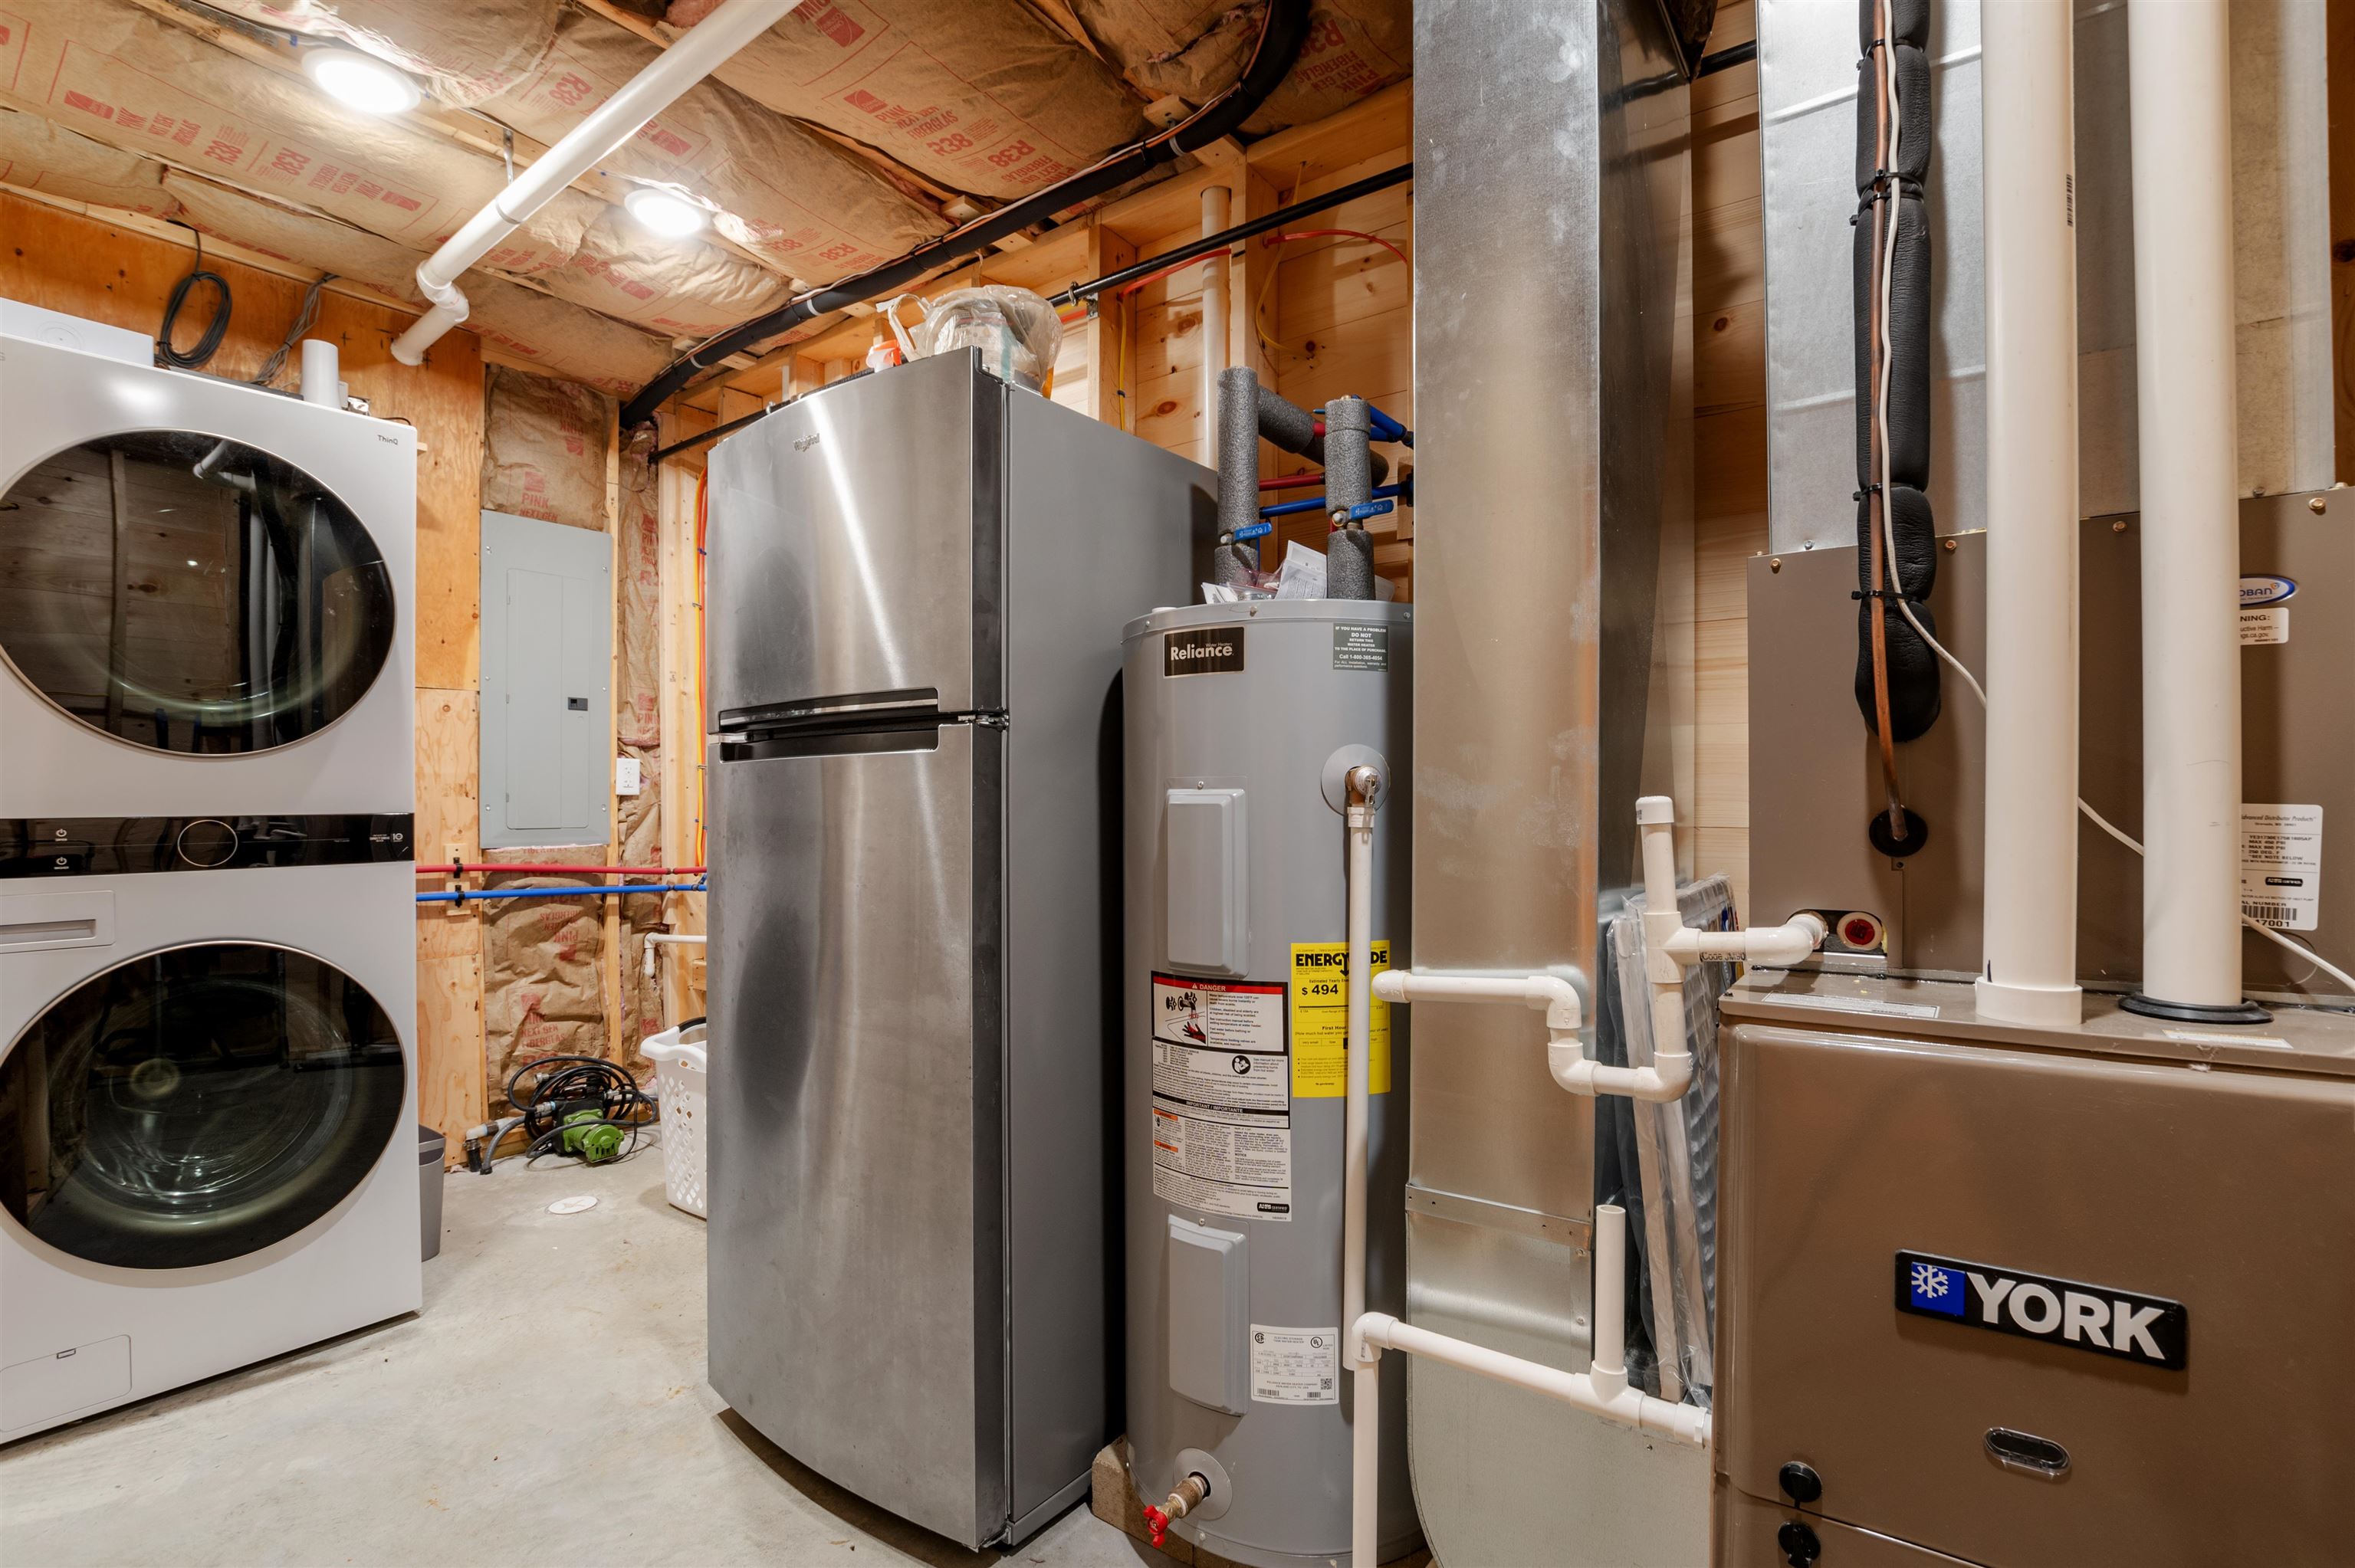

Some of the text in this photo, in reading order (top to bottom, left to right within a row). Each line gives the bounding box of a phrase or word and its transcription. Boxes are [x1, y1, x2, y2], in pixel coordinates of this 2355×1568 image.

[1295, 51, 1359, 83] FIBERGLAS
[1338, 60, 1368, 77] NEXT
[549, 71, 593, 106] R38
[1336, 69, 1380, 93] PINK
[907, 110, 958, 139] FIBERGLAS
[988, 139, 1035, 167] R38
[1001, 155, 1053, 182] FIBERGLAS
[1040, 161, 1064, 175] NEXT
[819, 242, 859, 261] R38
[377, 435, 399, 444] ThinQ
[521, 493, 550, 508] PINK
[1171, 644, 1233, 661] Reliance
[1302, 984, 1338, 996] $ 494
[1186, 1101, 1210, 1110] IMPORTANT
[1966, 1271, 2166, 1360] YORK
